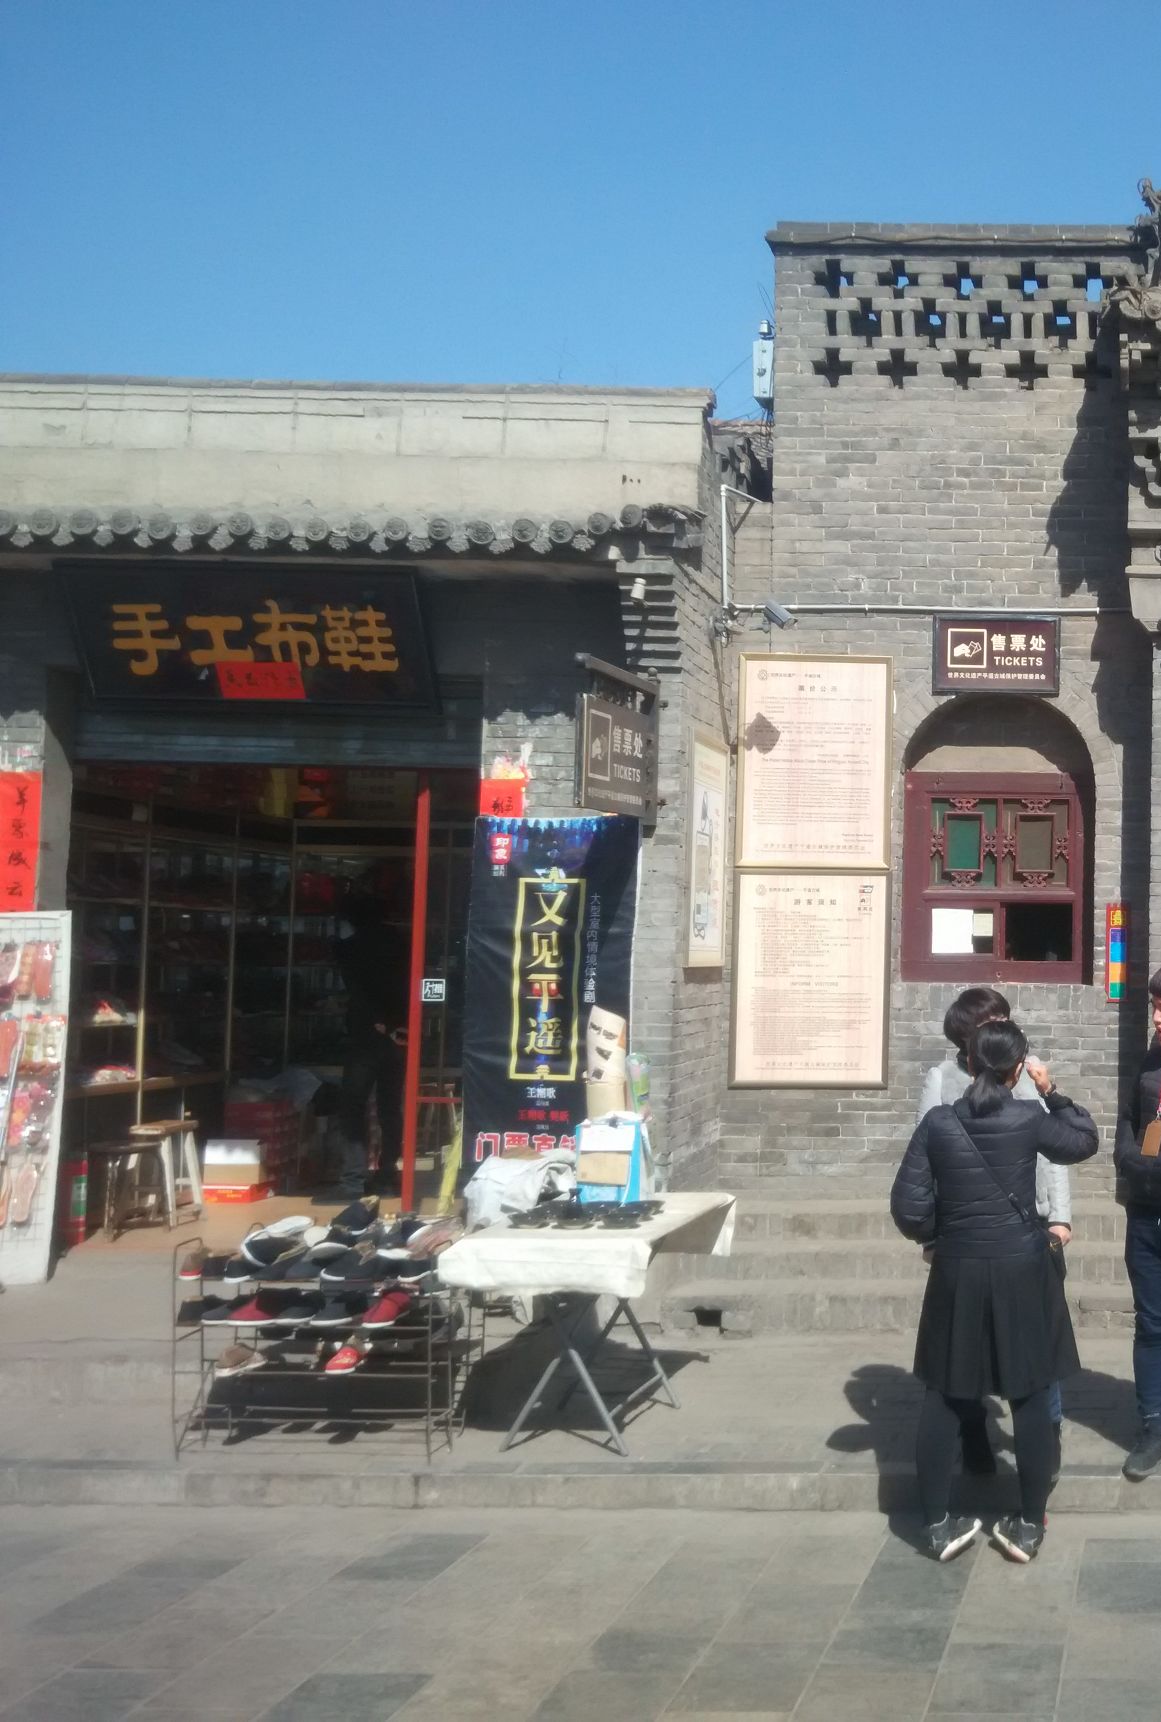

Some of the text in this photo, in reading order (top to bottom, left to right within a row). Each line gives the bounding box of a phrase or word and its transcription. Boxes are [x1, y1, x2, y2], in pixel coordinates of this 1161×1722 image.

[112, 600, 399, 675] 手工布鞋
[991, 633, 1046, 652] 售票处
[993, 656, 1043, 667] TICKETS
[612, 725, 644, 759] 售票处
[612, 763, 641, 783] TICKETS
[525, 889, 568, 1055] 又见平遥
